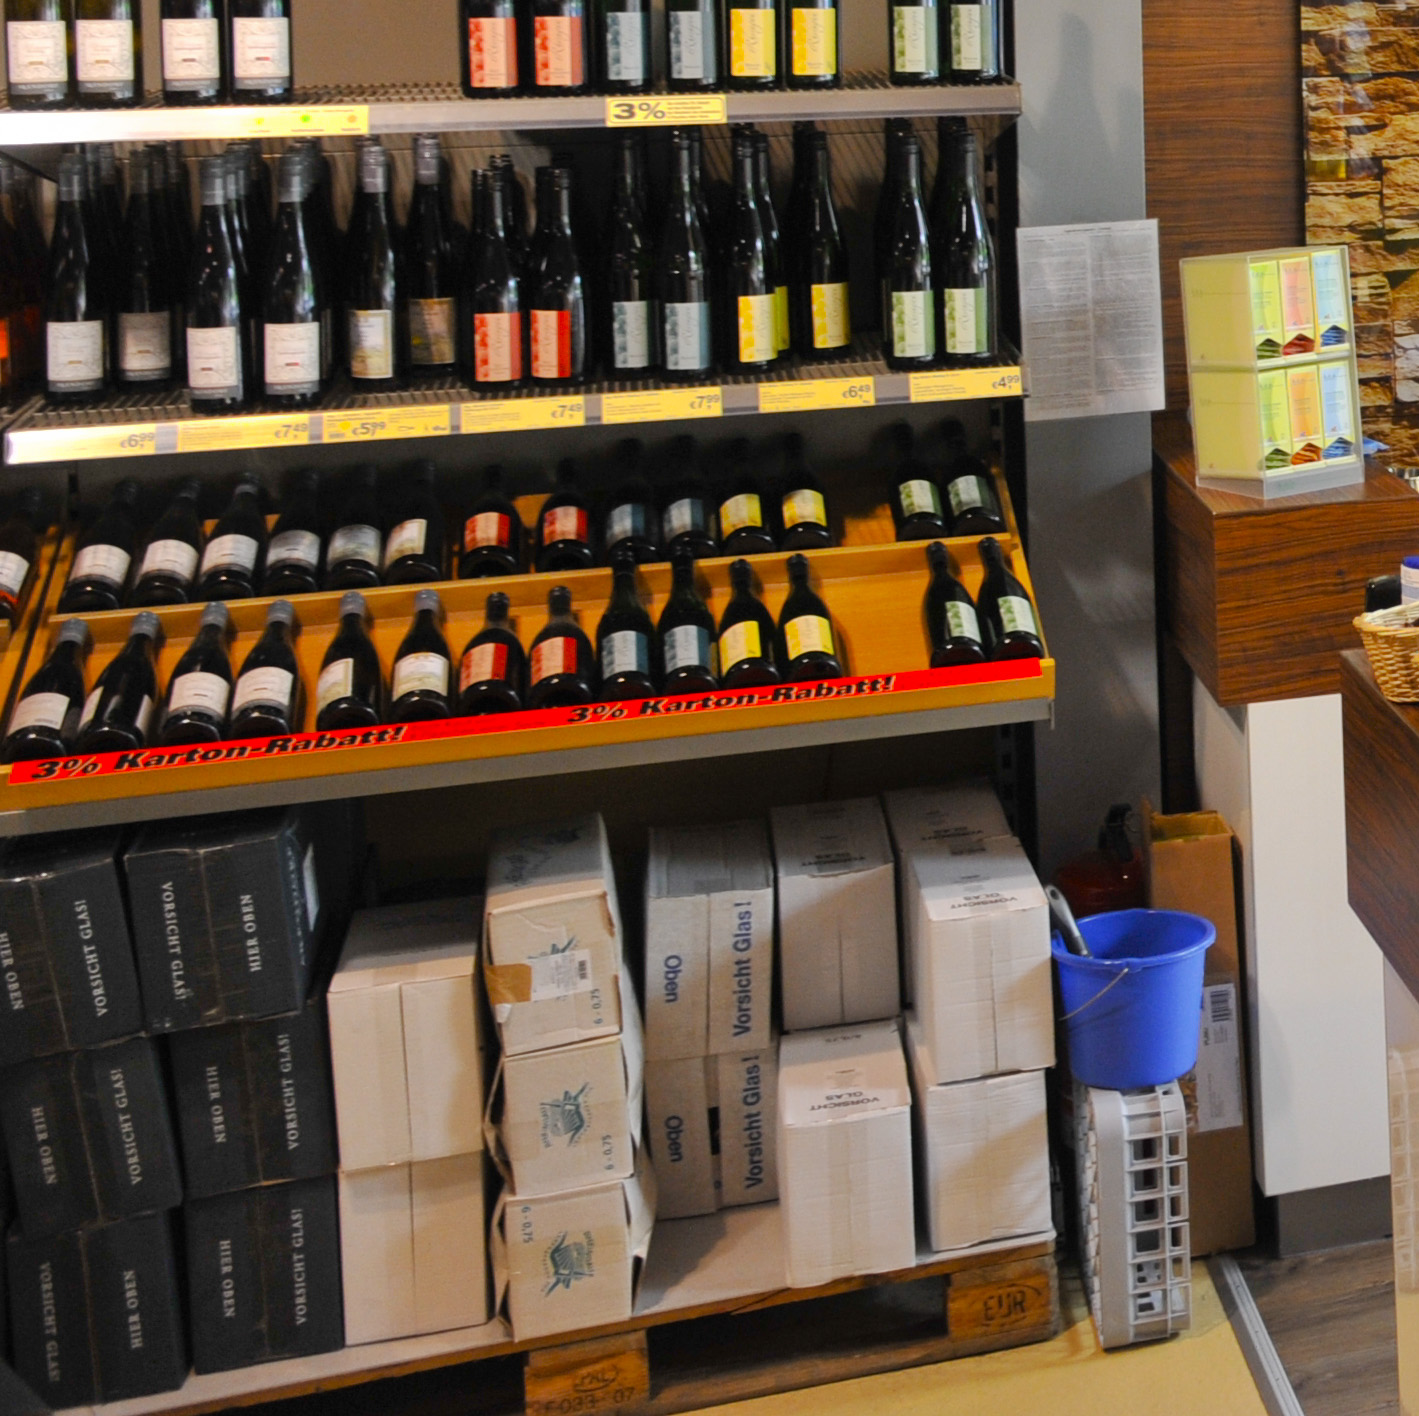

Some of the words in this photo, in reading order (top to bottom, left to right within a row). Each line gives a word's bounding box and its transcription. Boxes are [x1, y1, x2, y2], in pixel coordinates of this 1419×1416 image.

[613, 102, 666, 120] 3%
[567, 703, 628, 724] 3%
[639, 674, 897, 717] Karton-Rabatt!
[30, 757, 102, 781] 3%
[113, 725, 410, 772] Karton-Rabatt!
[73, 899, 93, 940] GLAS!
[240, 895, 256, 933] OBEN
[950, 896, 1019, 910] VORSICHT
[0, 931, 14, 968] HIER
[161, 881, 181, 955] VORSICHT
[171, 959, 188, 1001] GLAS!
[246, 937, 262, 972] HIER
[5, 971, 25, 1011] OBEN
[83, 945, 108, 1017] VORSICHT
[664, 954, 682, 1004] Oben
[732, 957, 751, 1038] Vorsicht
[277, 1034, 292, 1073] GLAS!
[110, 1068, 129, 1109] GLAS!
[206, 1066, 220, 1101] HIER
[31, 1106, 48, 1142] HIER
[281, 1078, 299, 1151] VORSICHT
[808, 1097, 880, 1111] VORSICHT
[210, 1105, 227, 1144] OBEN
[664, 1115, 683, 1164] Oben
[39, 1146, 58, 1185] OBEN
[118, 1113, 143, 1185] VORSICHT
[743, 1110, 764, 1189] Vorsicht
[290, 1208, 304, 1248] GLAS!
[219, 1239, 233, 1276] HIER
[123, 1270, 139, 1309] OBEN
[222, 1278, 236, 1318] OBEN
[293, 1252, 307, 1326] VORSICHT
[128, 1312, 143, 1349] HIER
